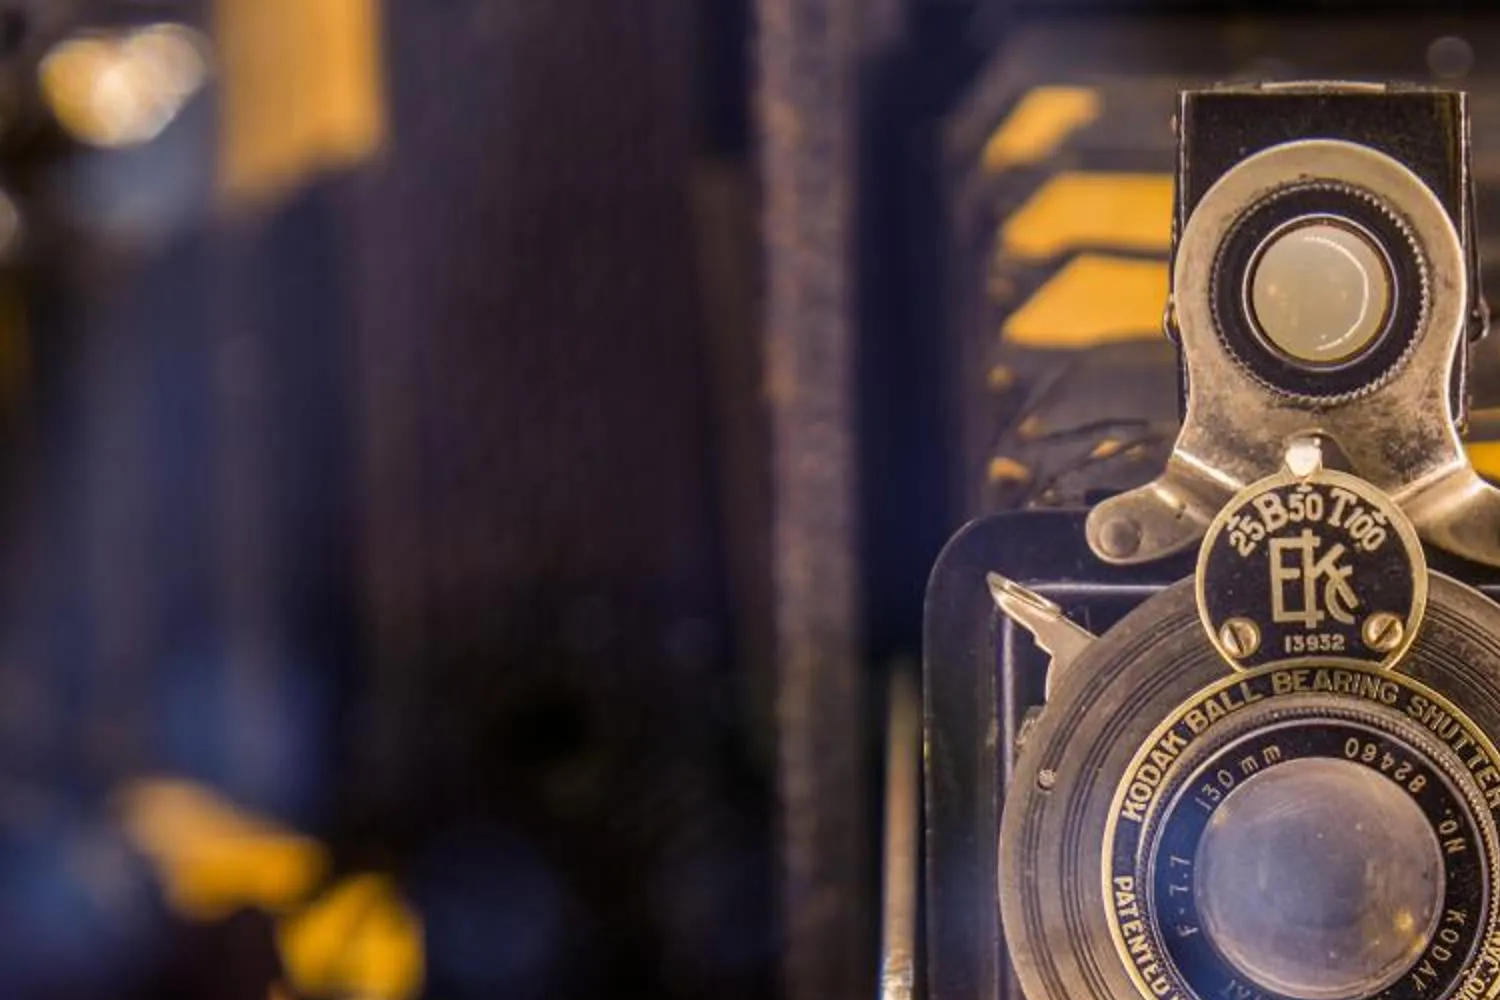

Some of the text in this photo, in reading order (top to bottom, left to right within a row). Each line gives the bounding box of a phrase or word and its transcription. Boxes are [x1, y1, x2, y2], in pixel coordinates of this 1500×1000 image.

[1228, 488, 1388, 557] 25 B 50 T 100
[1284, 634, 1346, 654] 13932
[1121, 730, 1188, 823] KODAK
[1184, 682, 1264, 735] BALL
[1271, 669, 1400, 704] BEARING
[1113, 875, 1171, 997] PATENTED
